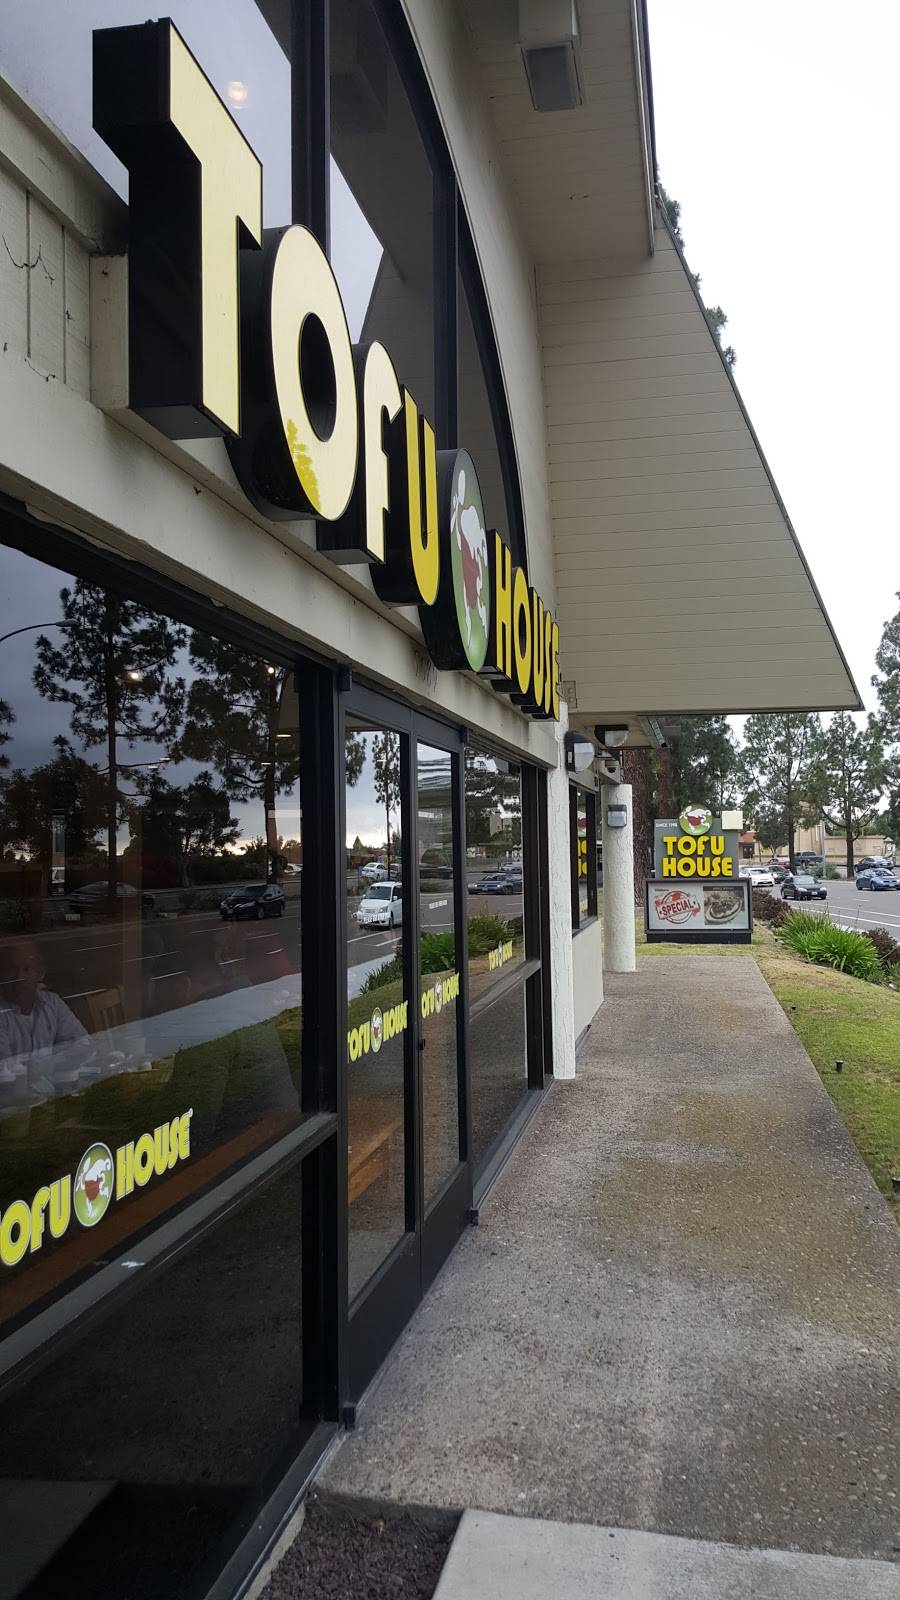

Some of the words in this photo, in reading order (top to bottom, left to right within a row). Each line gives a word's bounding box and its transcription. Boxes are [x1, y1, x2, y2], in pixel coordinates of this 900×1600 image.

[168, 16, 439, 606] TOFU
[495, 530, 560, 721] HOUSE
[663, 835, 725, 856] TOFU
[662, 857, 734, 877] HOUSE
[662, 900, 694, 916] SPECIAL
[0, 1174, 71, 1266] OFU
[116, 1112, 191, 1200] HOUSE
